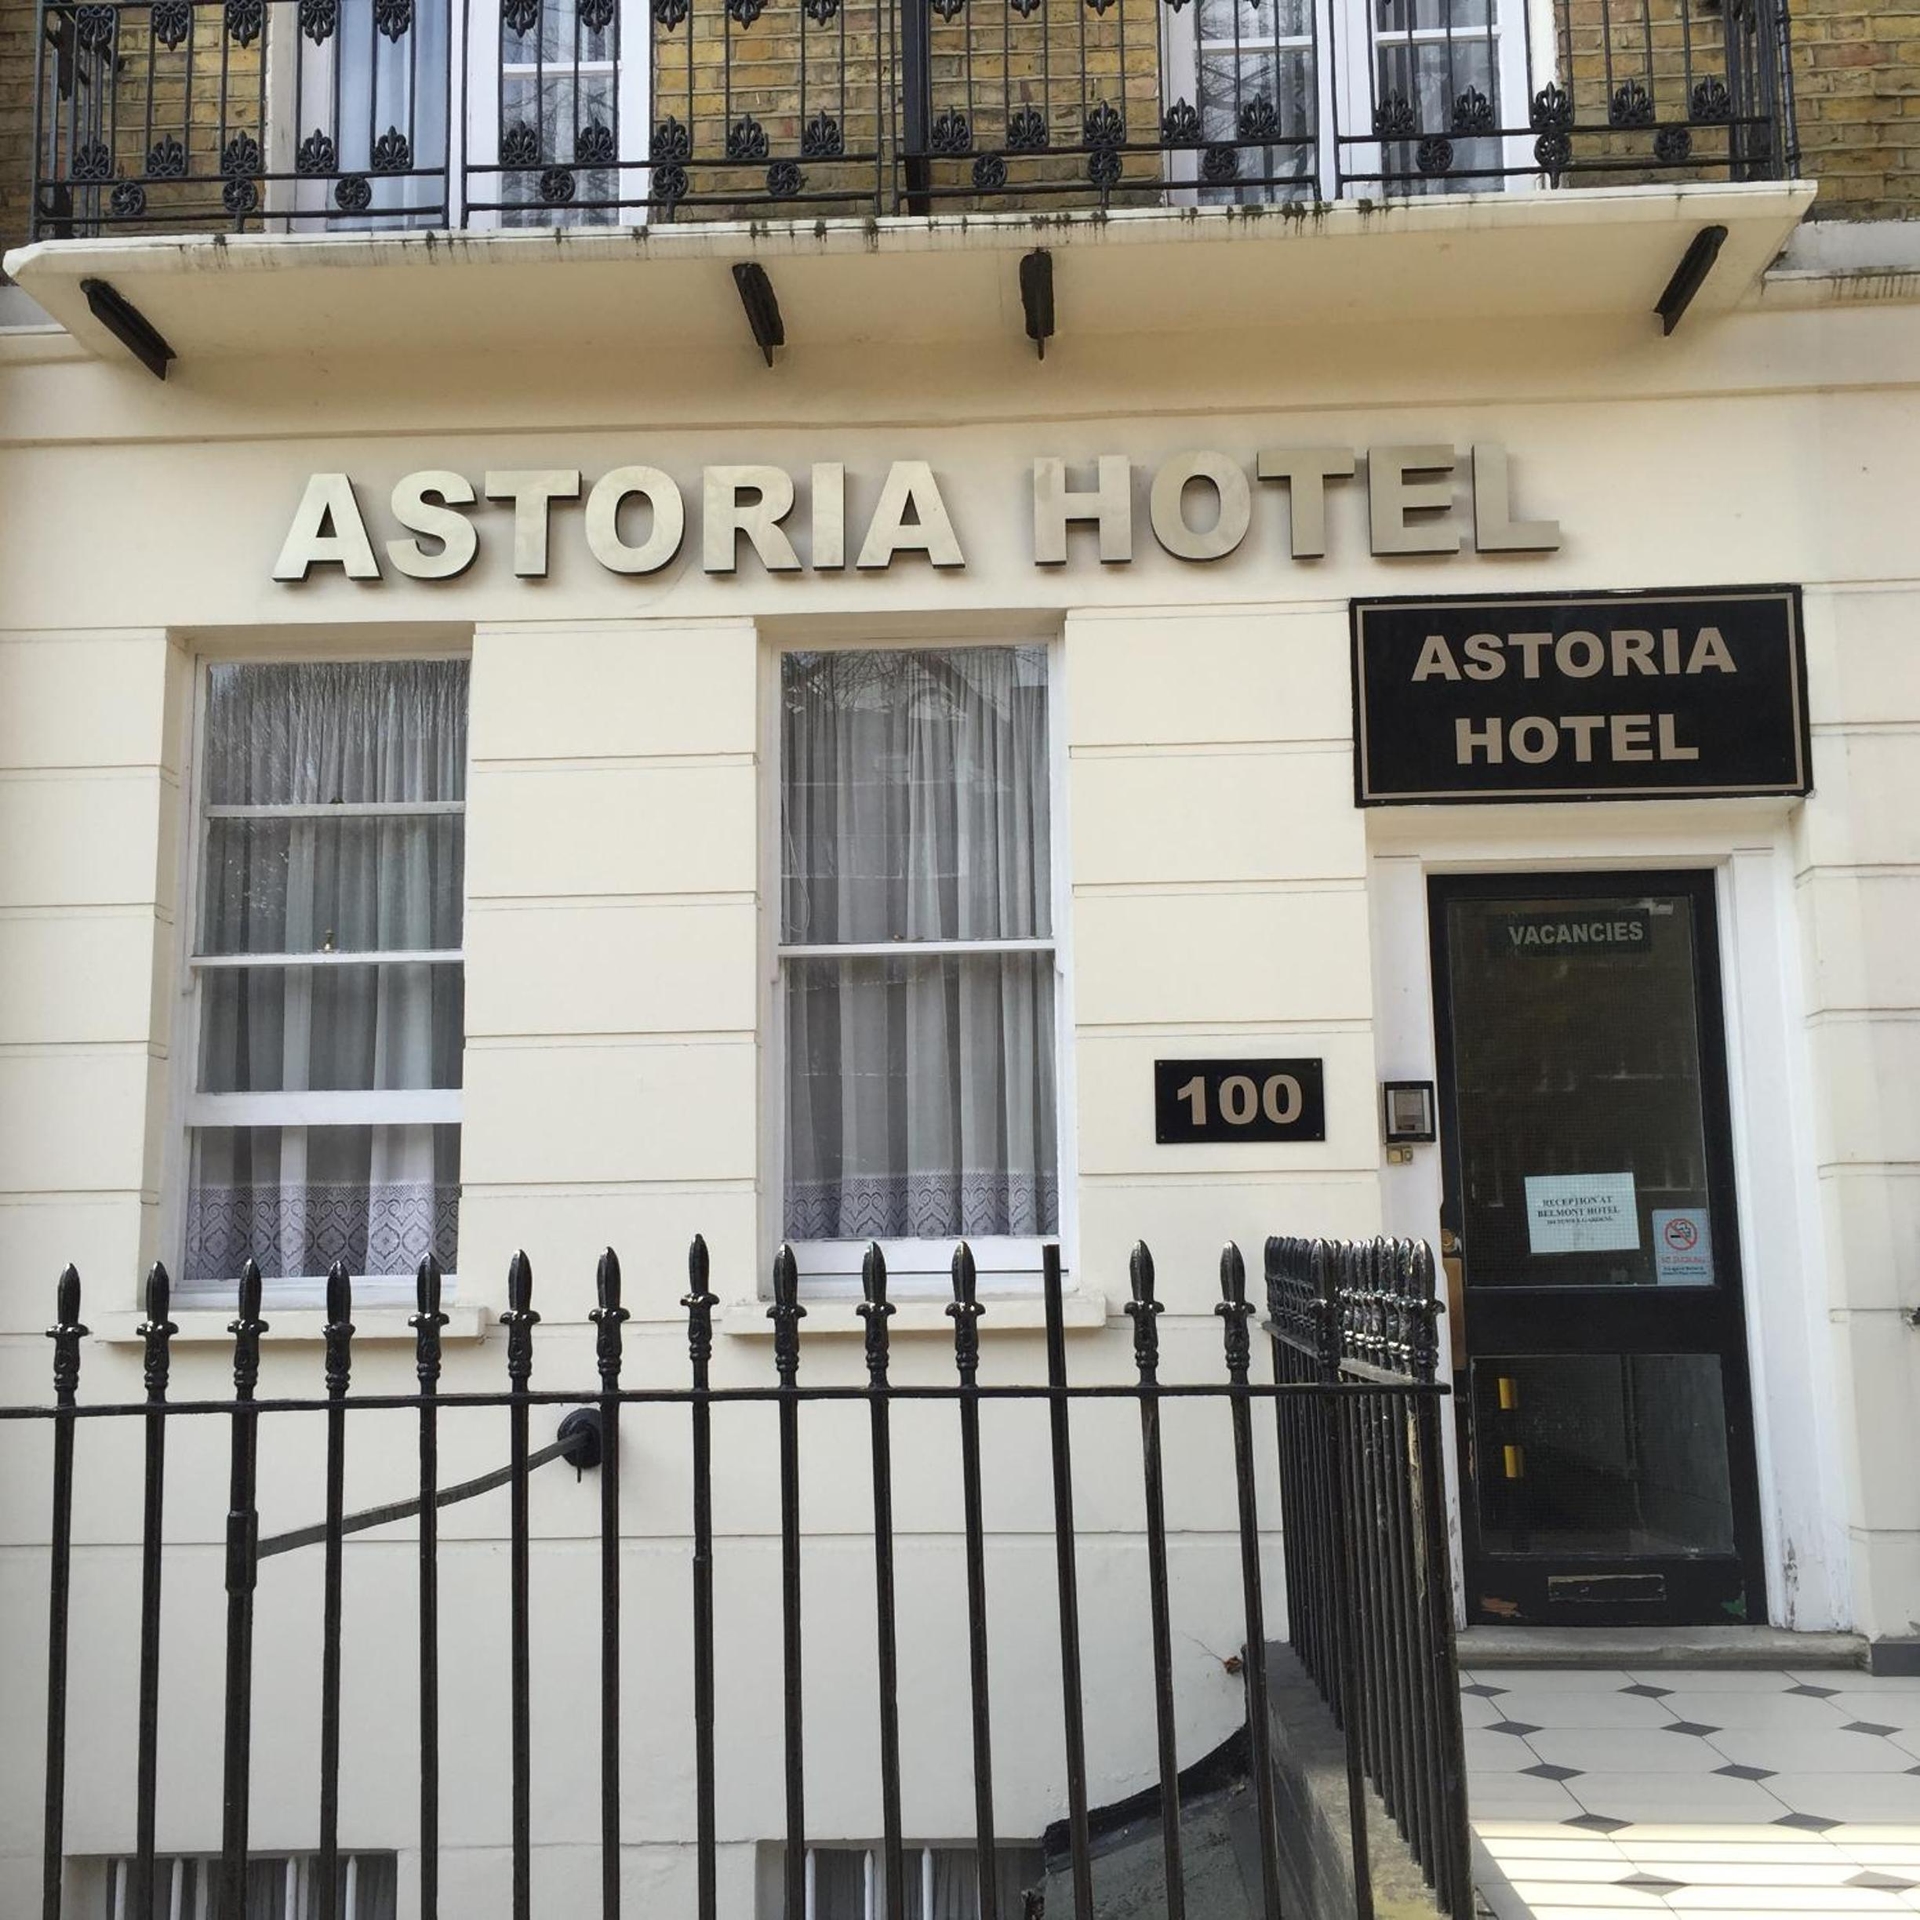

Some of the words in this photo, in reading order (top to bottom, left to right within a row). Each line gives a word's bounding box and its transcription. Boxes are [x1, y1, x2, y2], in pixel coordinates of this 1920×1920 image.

[272, 461, 966, 582] ASTORIA
[1033, 443, 1560, 566] HOTEL
[1411, 627, 1737, 682] ASTORIA
[1455, 713, 1699, 764] HOTEL
[1508, 921, 1644, 945] VACANCIES
[1176, 1074, 1303, 1125] 100
[1537, 1208, 1583, 1218] BELMONT
[1587, 1206, 1619, 1215] HOTEL
[1542, 1196, 1597, 1207] RECEPTION
